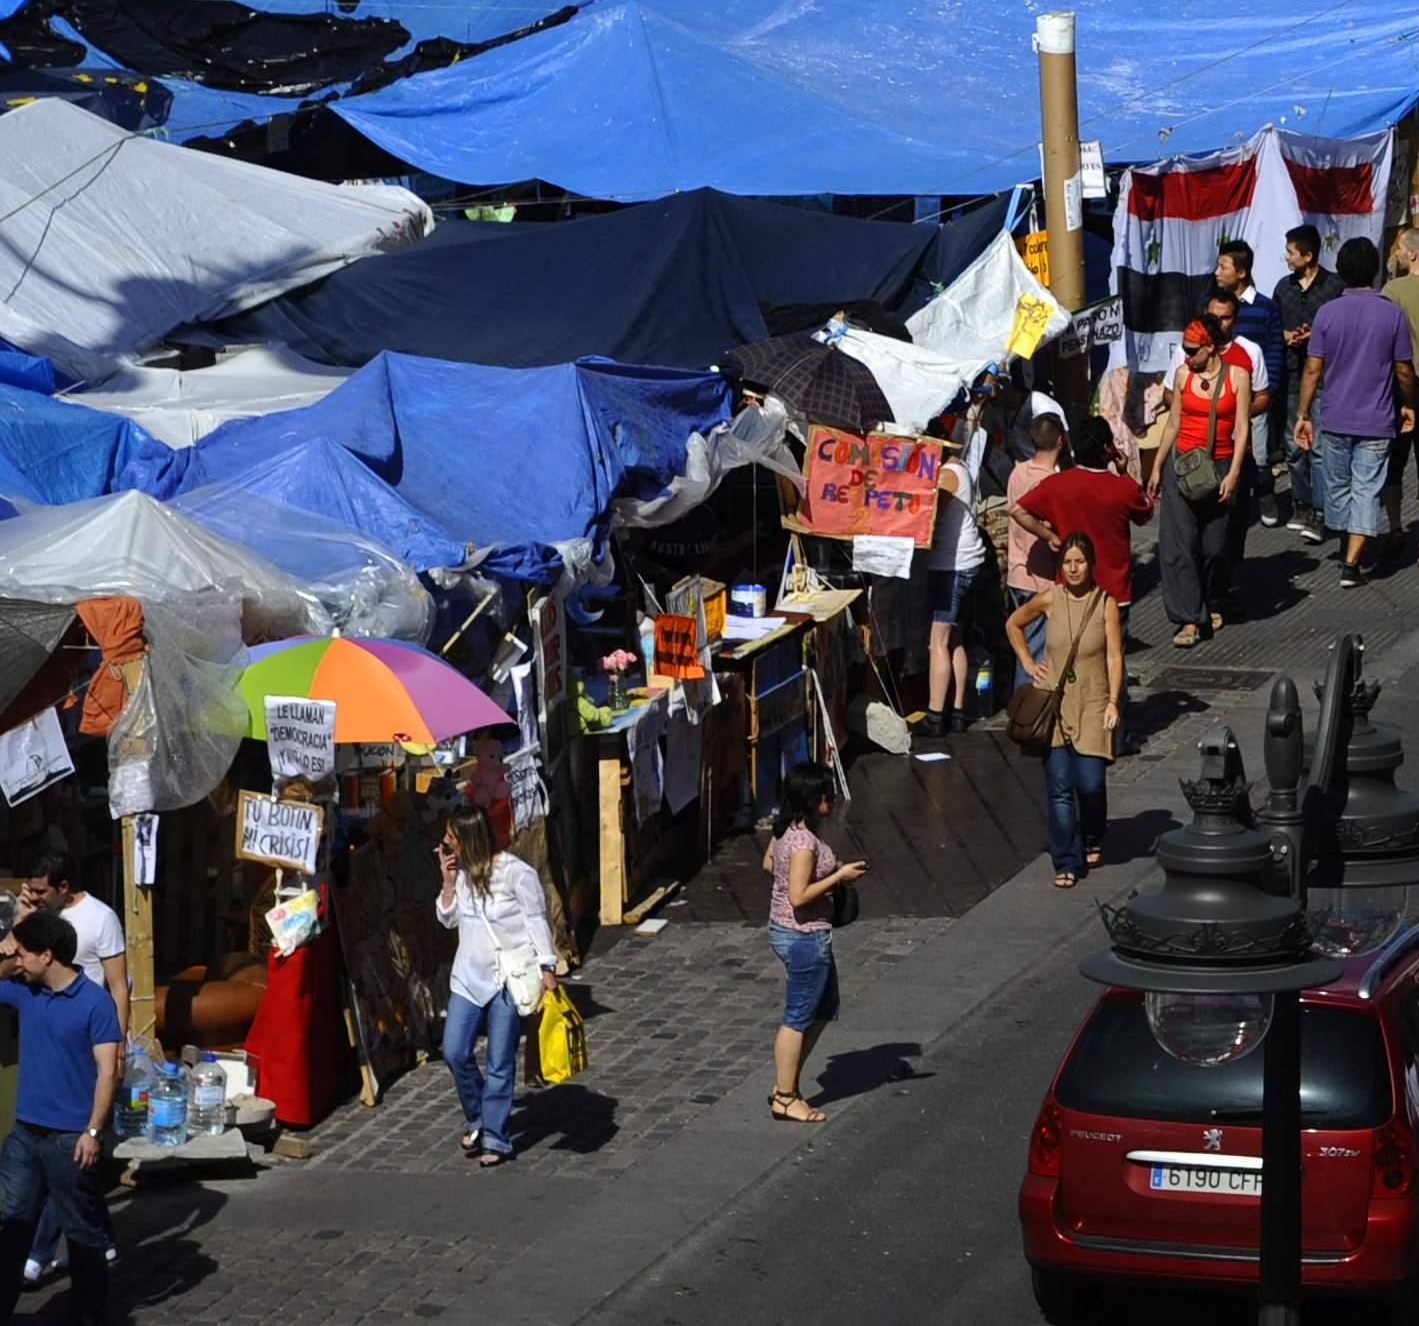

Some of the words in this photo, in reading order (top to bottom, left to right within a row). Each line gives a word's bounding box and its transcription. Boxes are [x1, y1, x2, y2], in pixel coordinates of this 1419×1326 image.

[849, 469, 878, 488] DE
[277, 705, 289, 720] LE
[1070, 1129, 1121, 1143] PEUGEOT
[1168, 1170, 1221, 1189] 6190
